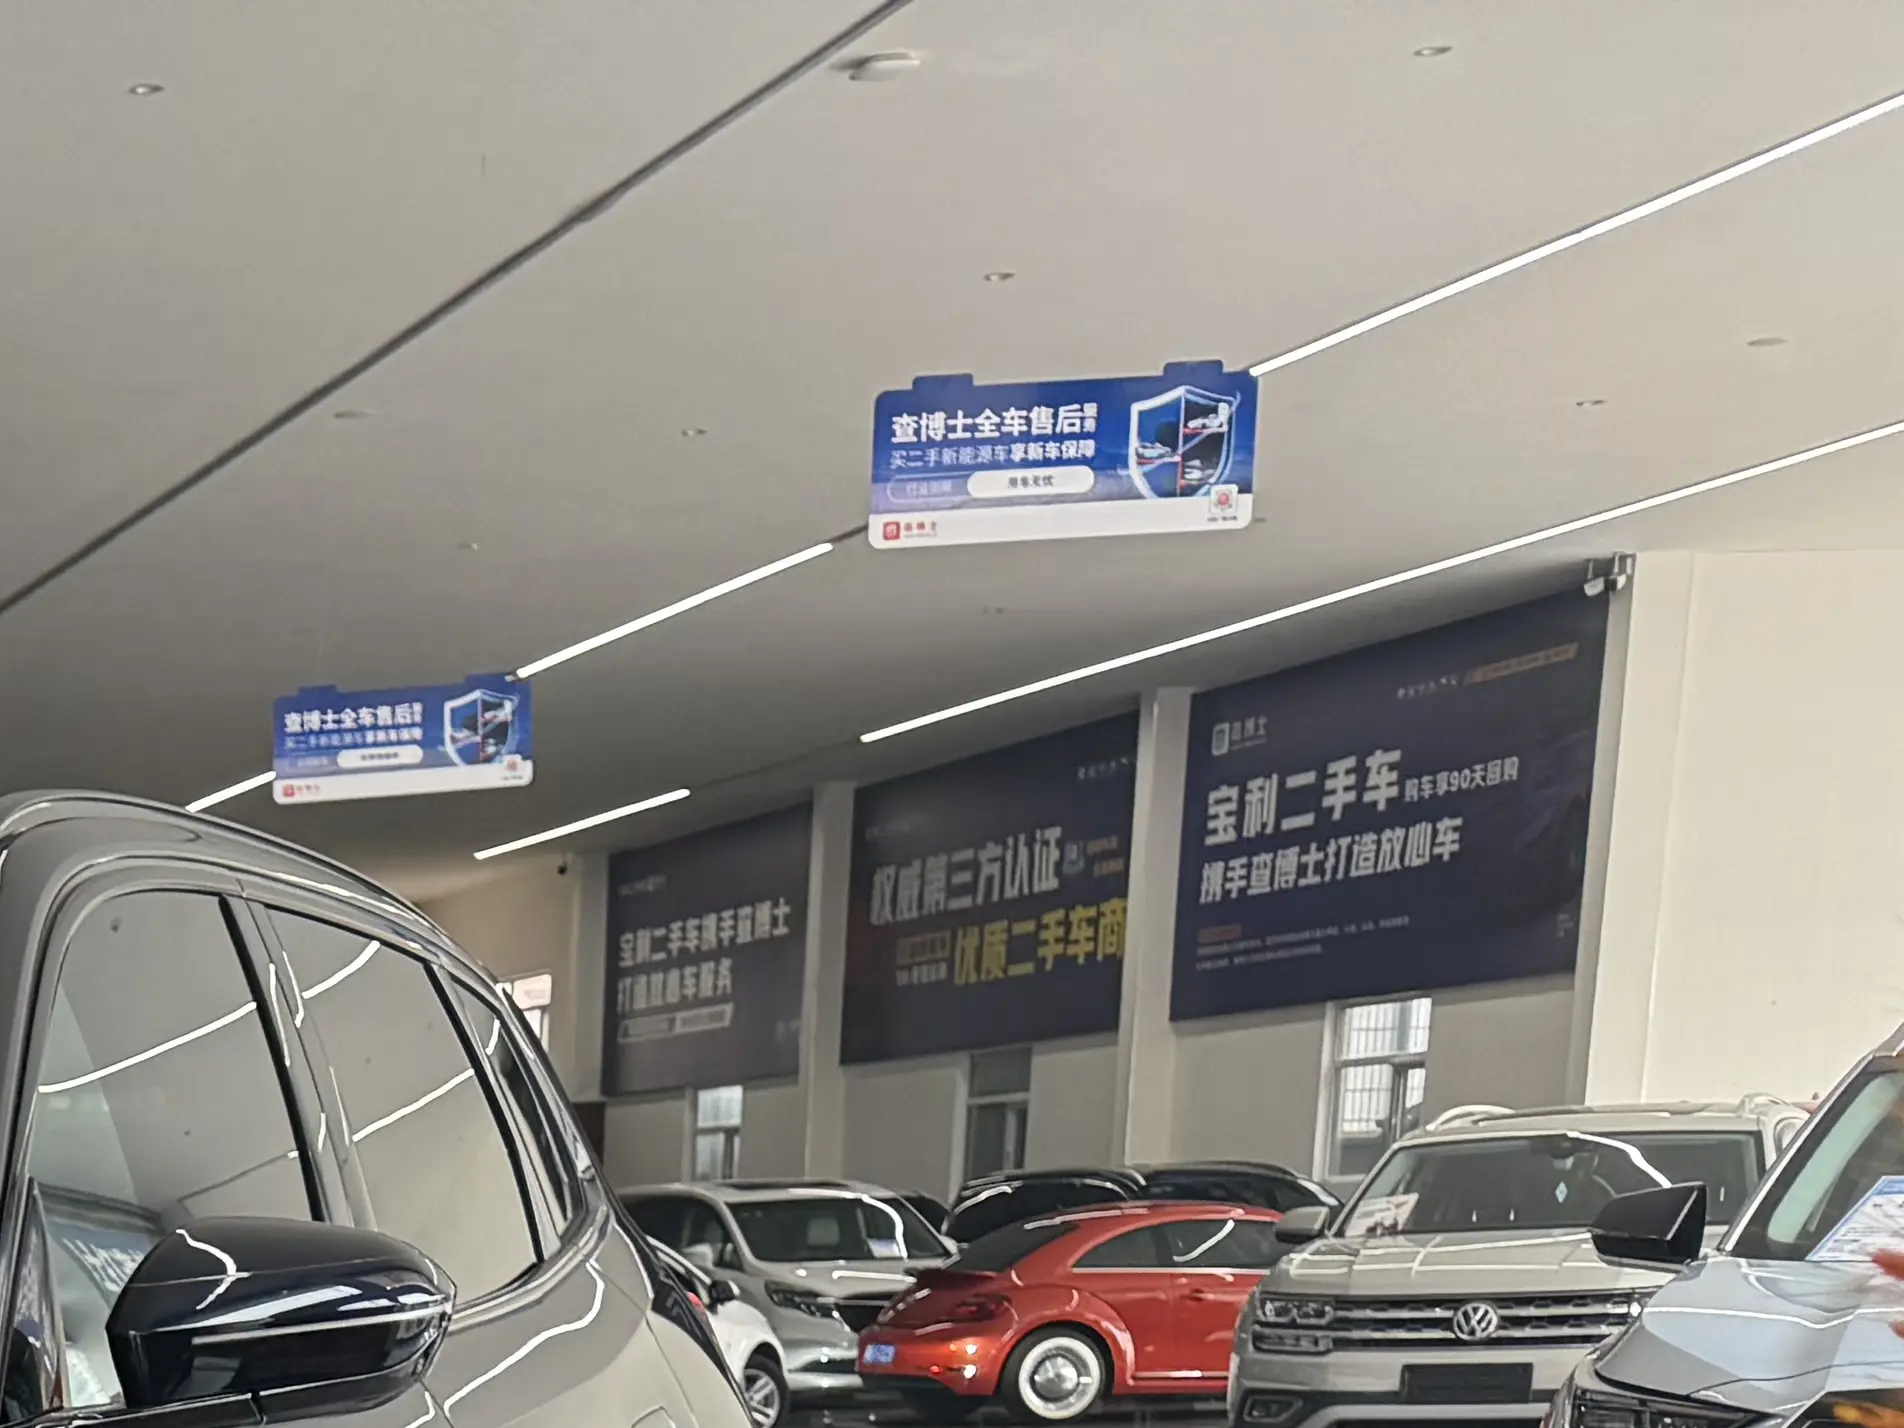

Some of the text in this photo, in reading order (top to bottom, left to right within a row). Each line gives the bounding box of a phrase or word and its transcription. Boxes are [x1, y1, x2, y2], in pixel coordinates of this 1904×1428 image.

[1204, 749, 1402, 846] 宝利二手车
[870, 826, 1062, 926] 权威第三方认证
[954, 898, 1128, 986] 优质二手车商
